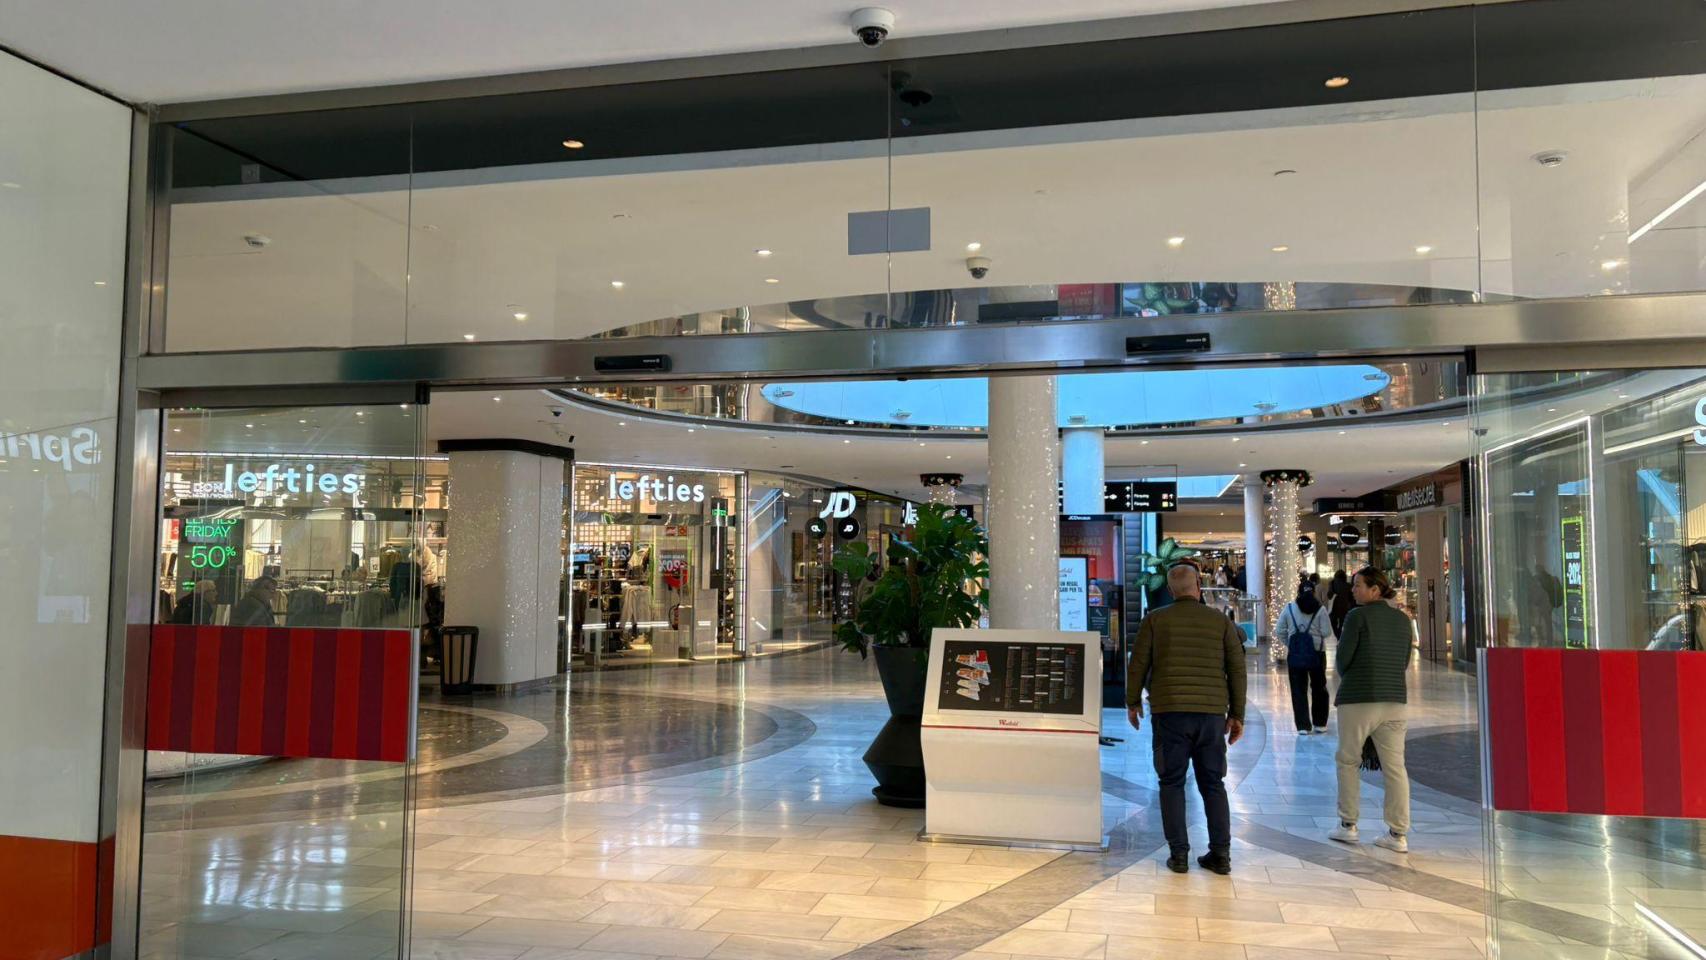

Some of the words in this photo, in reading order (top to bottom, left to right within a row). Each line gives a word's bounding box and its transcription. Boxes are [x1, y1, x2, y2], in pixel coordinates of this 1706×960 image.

[224, 463, 359, 494] lefties
[609, 473, 705, 503] lefties
[819, 491, 857, 519] JD
[185, 525, 231, 538] FRIDAY
[184, 546, 236, 569] -50%
